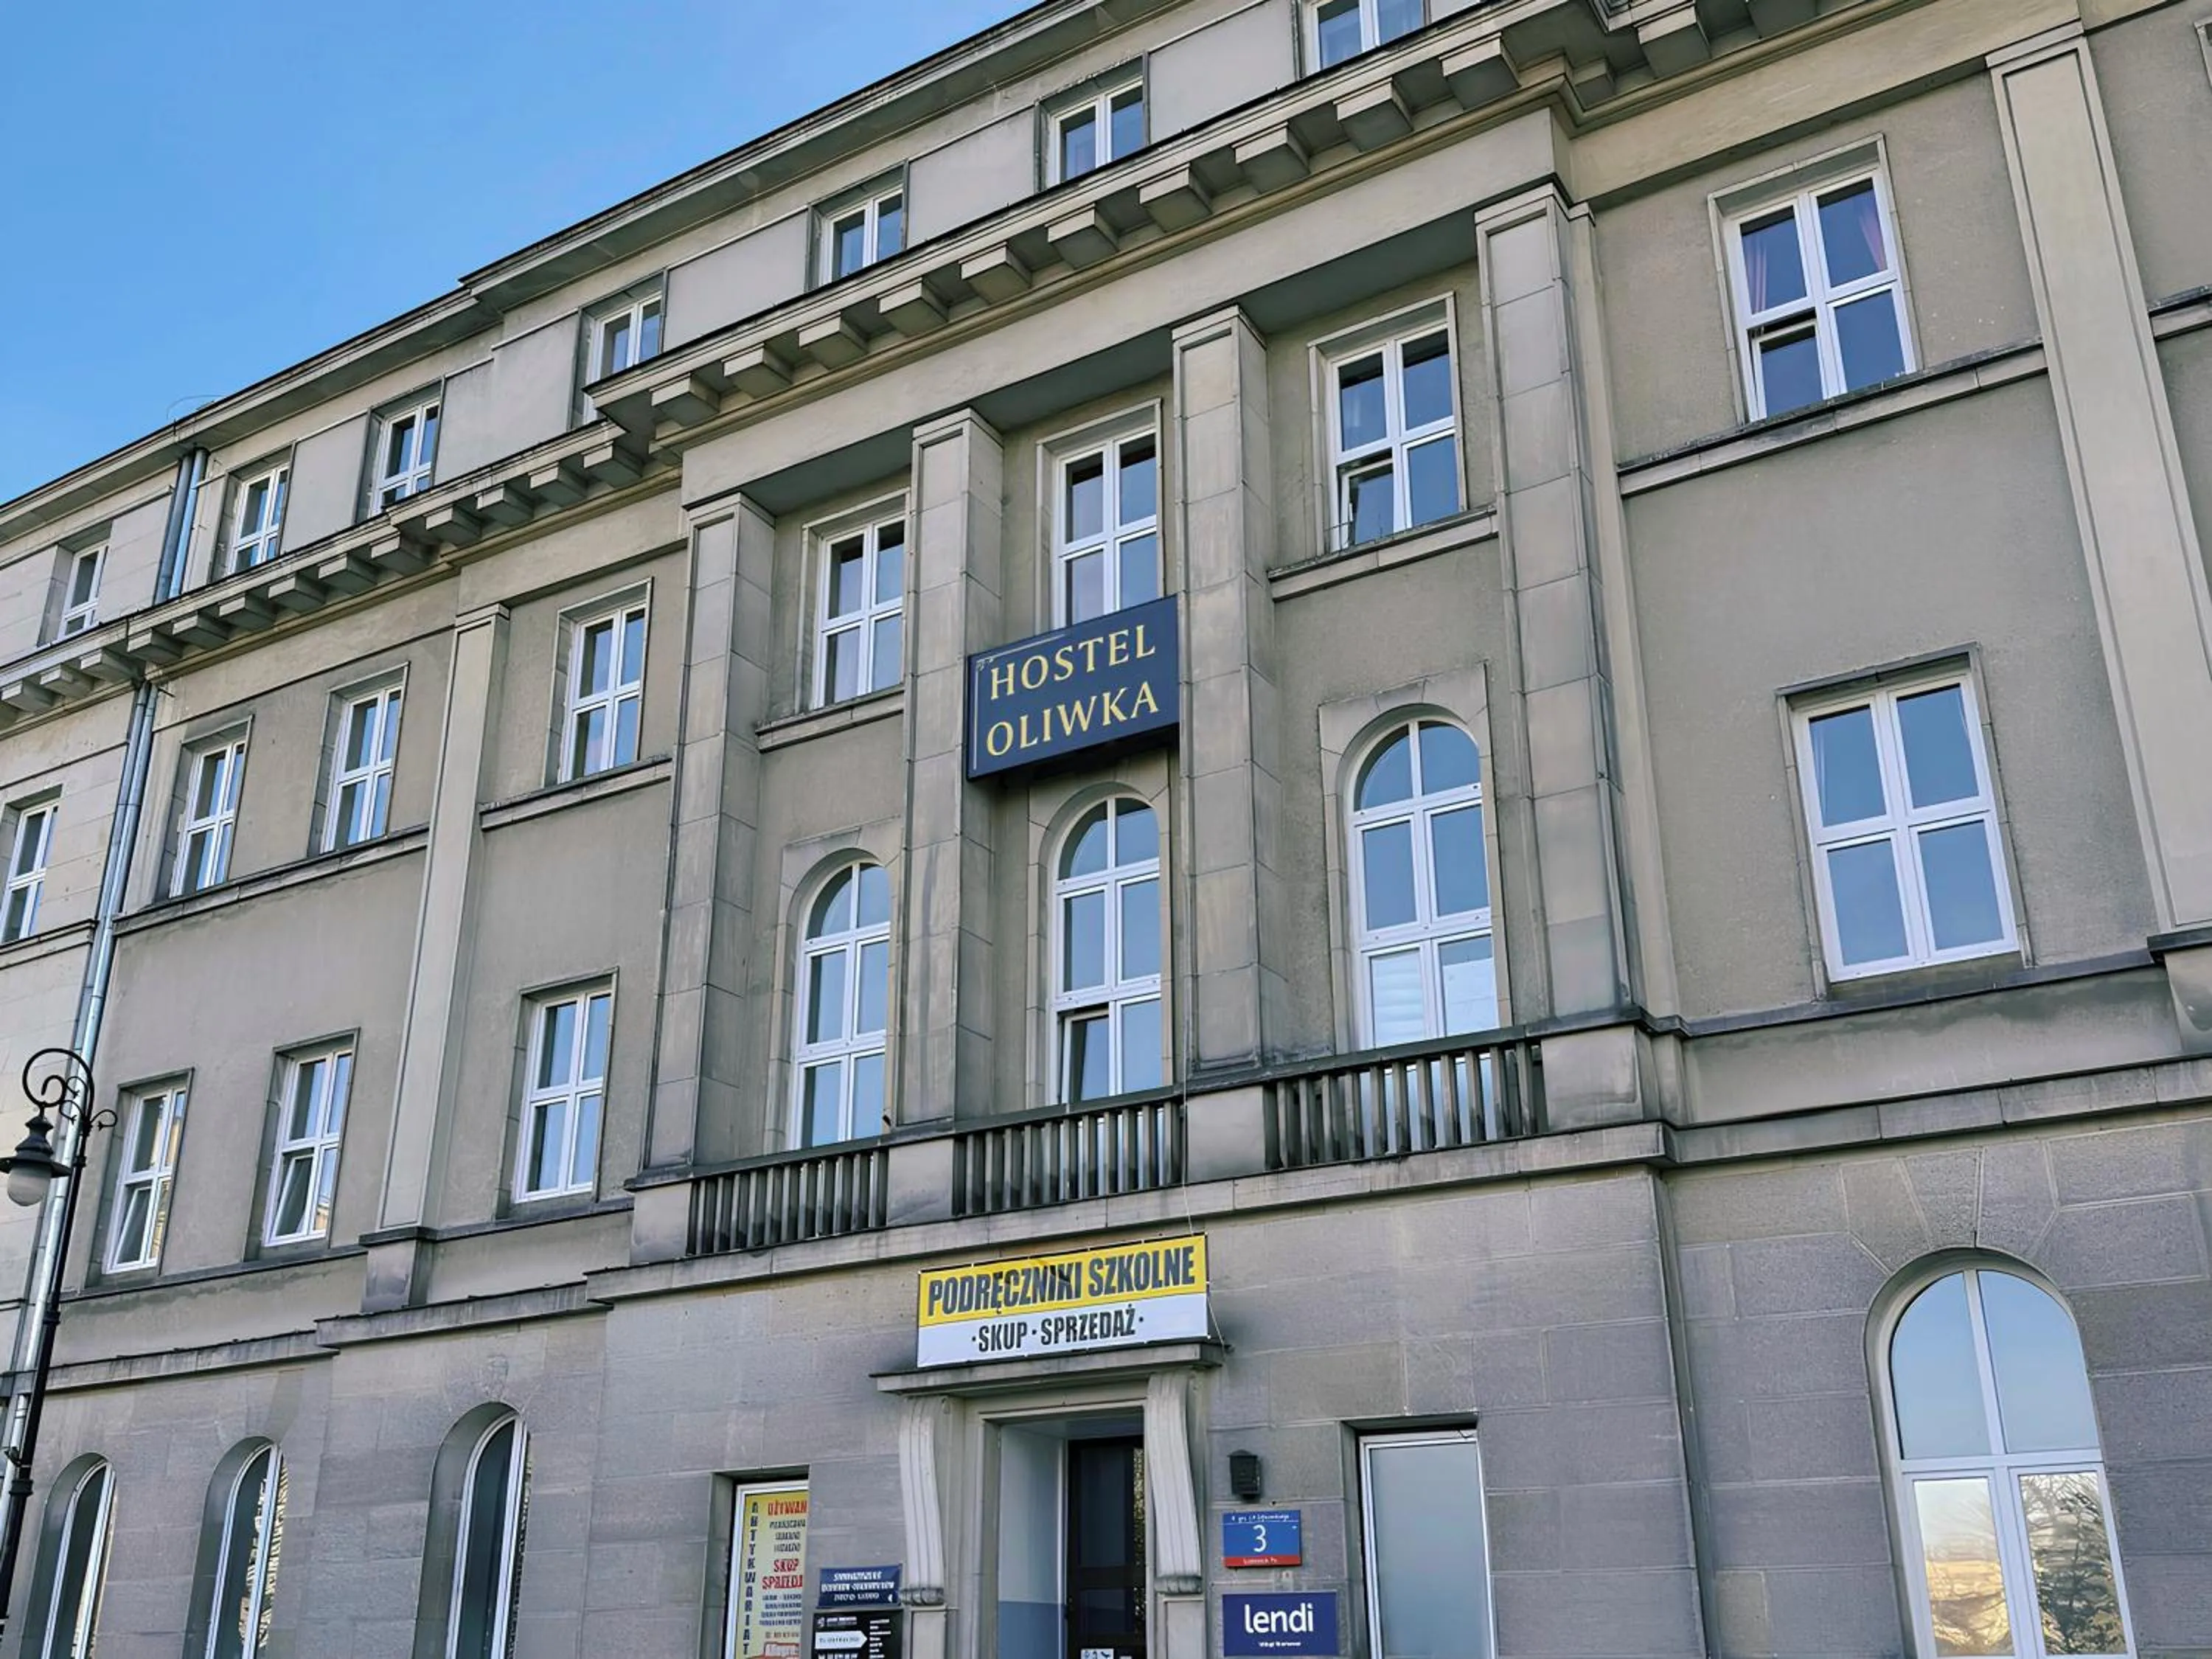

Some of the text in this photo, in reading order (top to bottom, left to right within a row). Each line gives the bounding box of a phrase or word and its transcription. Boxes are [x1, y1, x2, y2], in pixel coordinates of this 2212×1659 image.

[990, 625, 1156, 700] HOSTEL
[986, 681, 1159, 757] OLIWKA
[928, 1246, 1195, 1316] PODRĘCZNIKI SZKOLNE
[978, 1304, 1135, 1352] SKUP SPRZEDAŻ
[1253, 1524, 1267, 1552] 3
[1244, 1602, 1314, 1633] lendi
